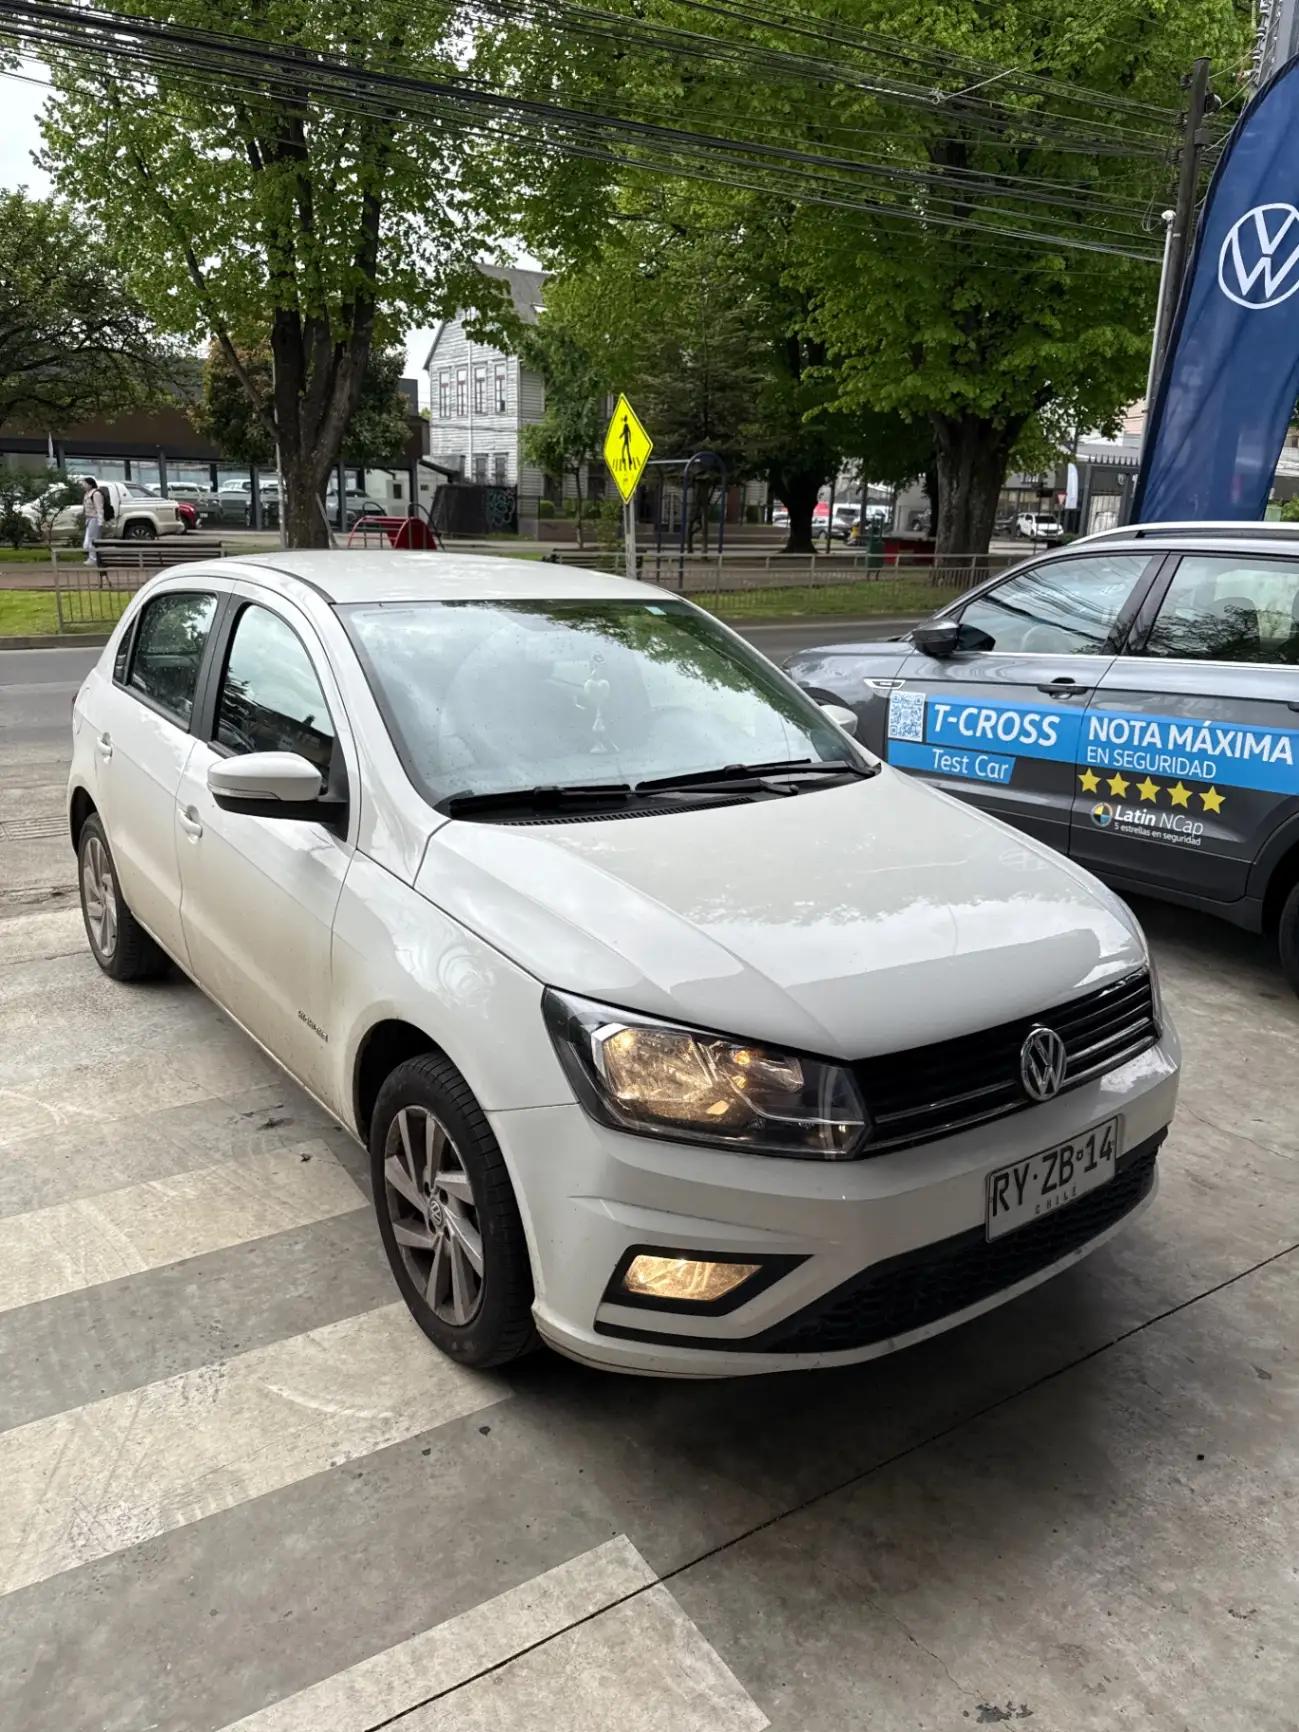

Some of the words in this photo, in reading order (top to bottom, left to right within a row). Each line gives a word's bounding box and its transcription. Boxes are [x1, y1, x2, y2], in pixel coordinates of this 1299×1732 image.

[933, 704, 1060, 747] T-CROSS
[1088, 716, 1162, 745] NOTA
[1167, 720, 1294, 765] MÁXIMA
[932, 748, 969, 774] Test
[975, 755, 1009, 781] Car
[1087, 746, 1110, 765] EN
[1113, 749, 1217, 779] SEGURIDAD
[1114, 805, 1156, 827] Latin
[1159, 813, 1204, 838] NCap
[1120, 825, 1151, 837] estrellas
[1151, 831, 1162, 839] en
[1162, 832, 1201, 846] seguridad
